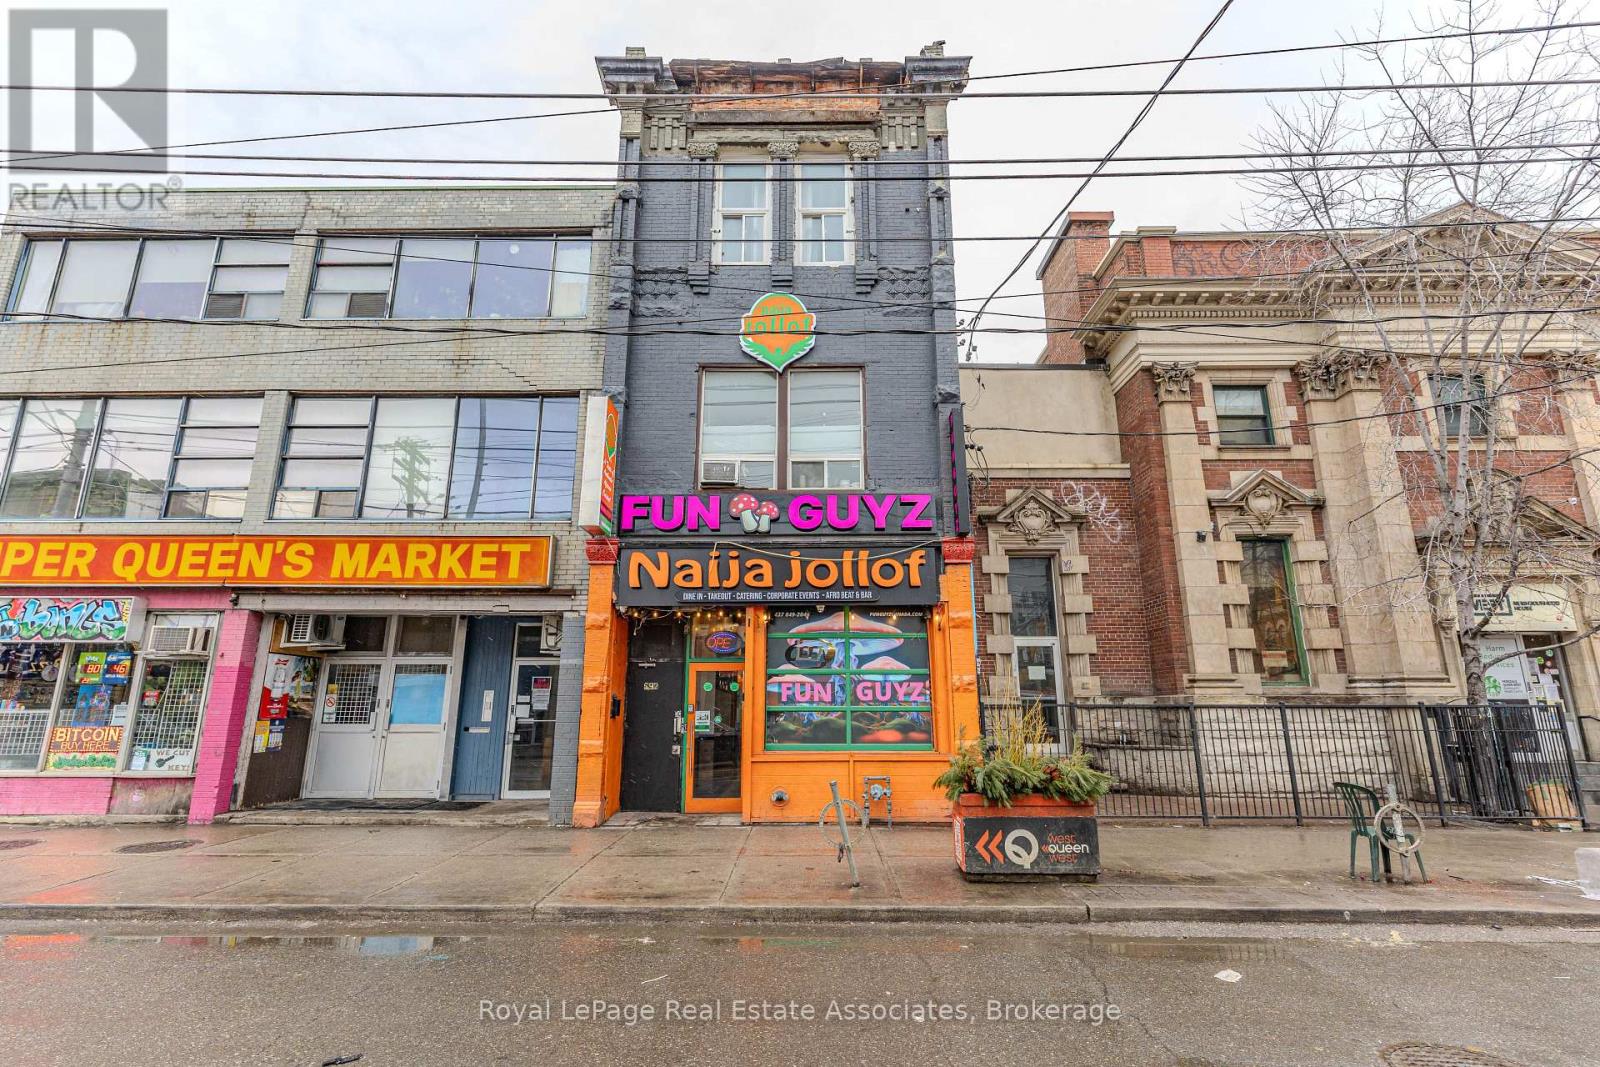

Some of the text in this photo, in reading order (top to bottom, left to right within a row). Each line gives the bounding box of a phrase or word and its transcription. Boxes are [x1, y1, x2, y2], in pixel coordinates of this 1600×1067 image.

[620, 495, 933, 531] FUN GUYZ
[0, 541, 531, 582] PER QUEEN'S MARKET
[628, 550, 927, 588] Naija jollof
[683, 592, 696, 600] DINE
[697, 592, 703, 600] IN
[707, 592, 732, 600] TAKEOUT
[736, 592, 762, 600] CATERING
[767, 592, 798, 600] CORPORATE
[825, 591, 840, 599] AFRO
[841, 591, 855, 599] BEAT
[860, 591, 873, 599] BAR
[706, 637, 736, 649] OPE
[781, 682, 925, 702] FUN GUYZ
[55, 727, 119, 741] BITCOIN
[61, 741, 110, 750] BUY HERE
[1048, 833, 1076, 843] west
[1050, 854, 1077, 863] west
